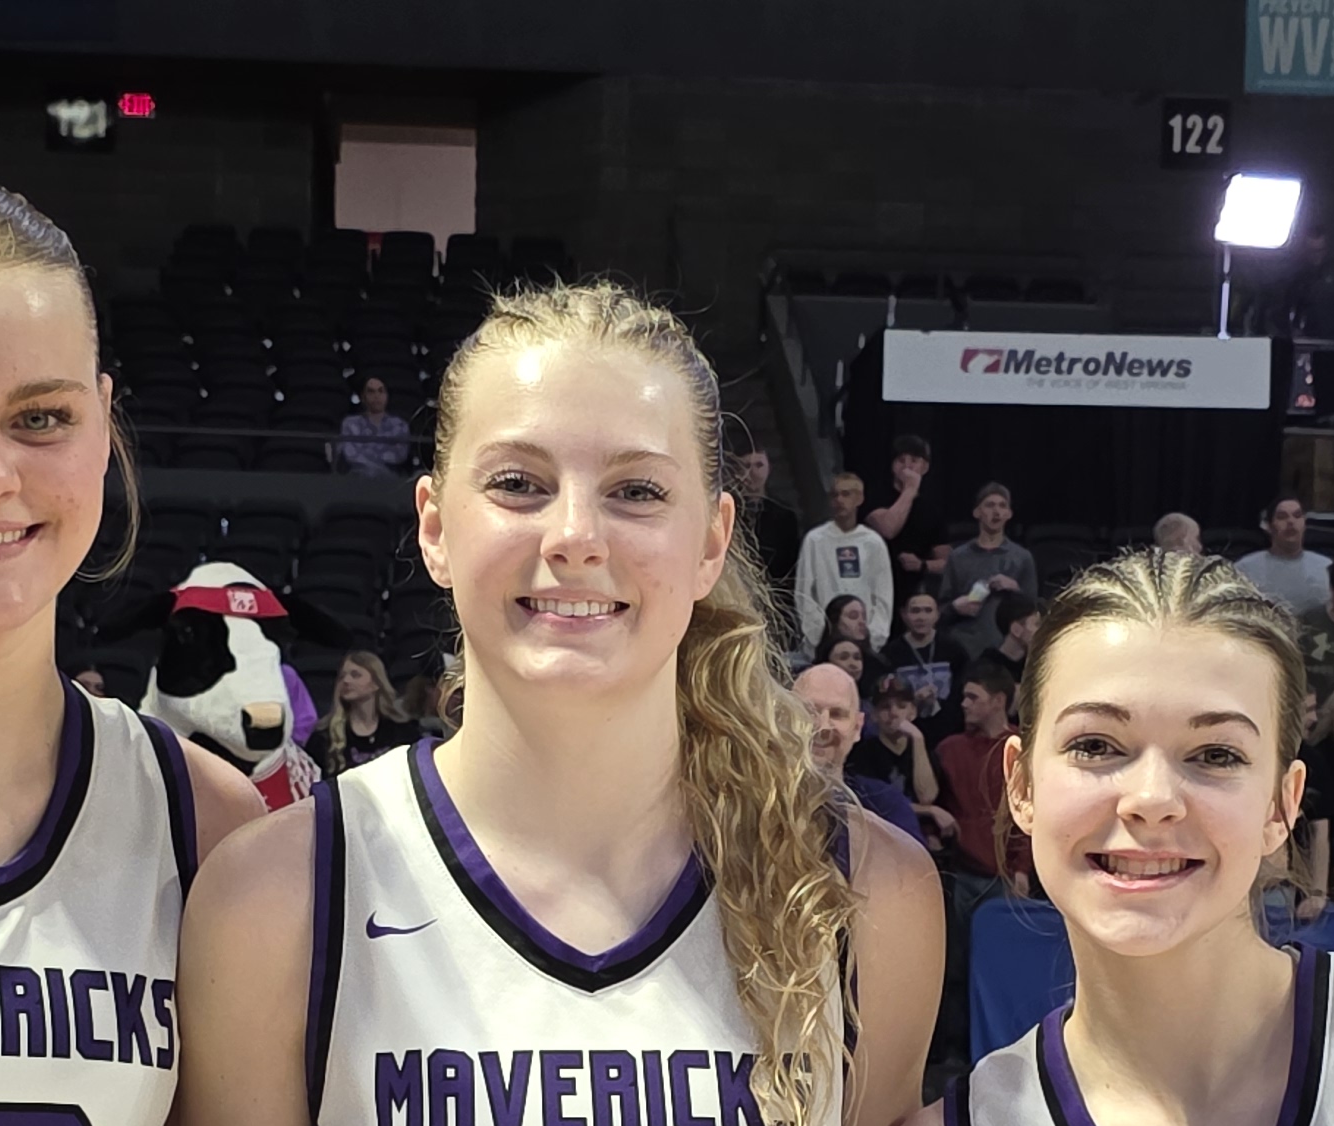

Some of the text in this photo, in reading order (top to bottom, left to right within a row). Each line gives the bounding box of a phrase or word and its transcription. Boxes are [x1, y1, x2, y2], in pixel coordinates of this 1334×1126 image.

[1259, 15, 1330, 75] WV
[1168, 114, 1224, 153] 122
[1003, 349, 1193, 379] MetroNews
